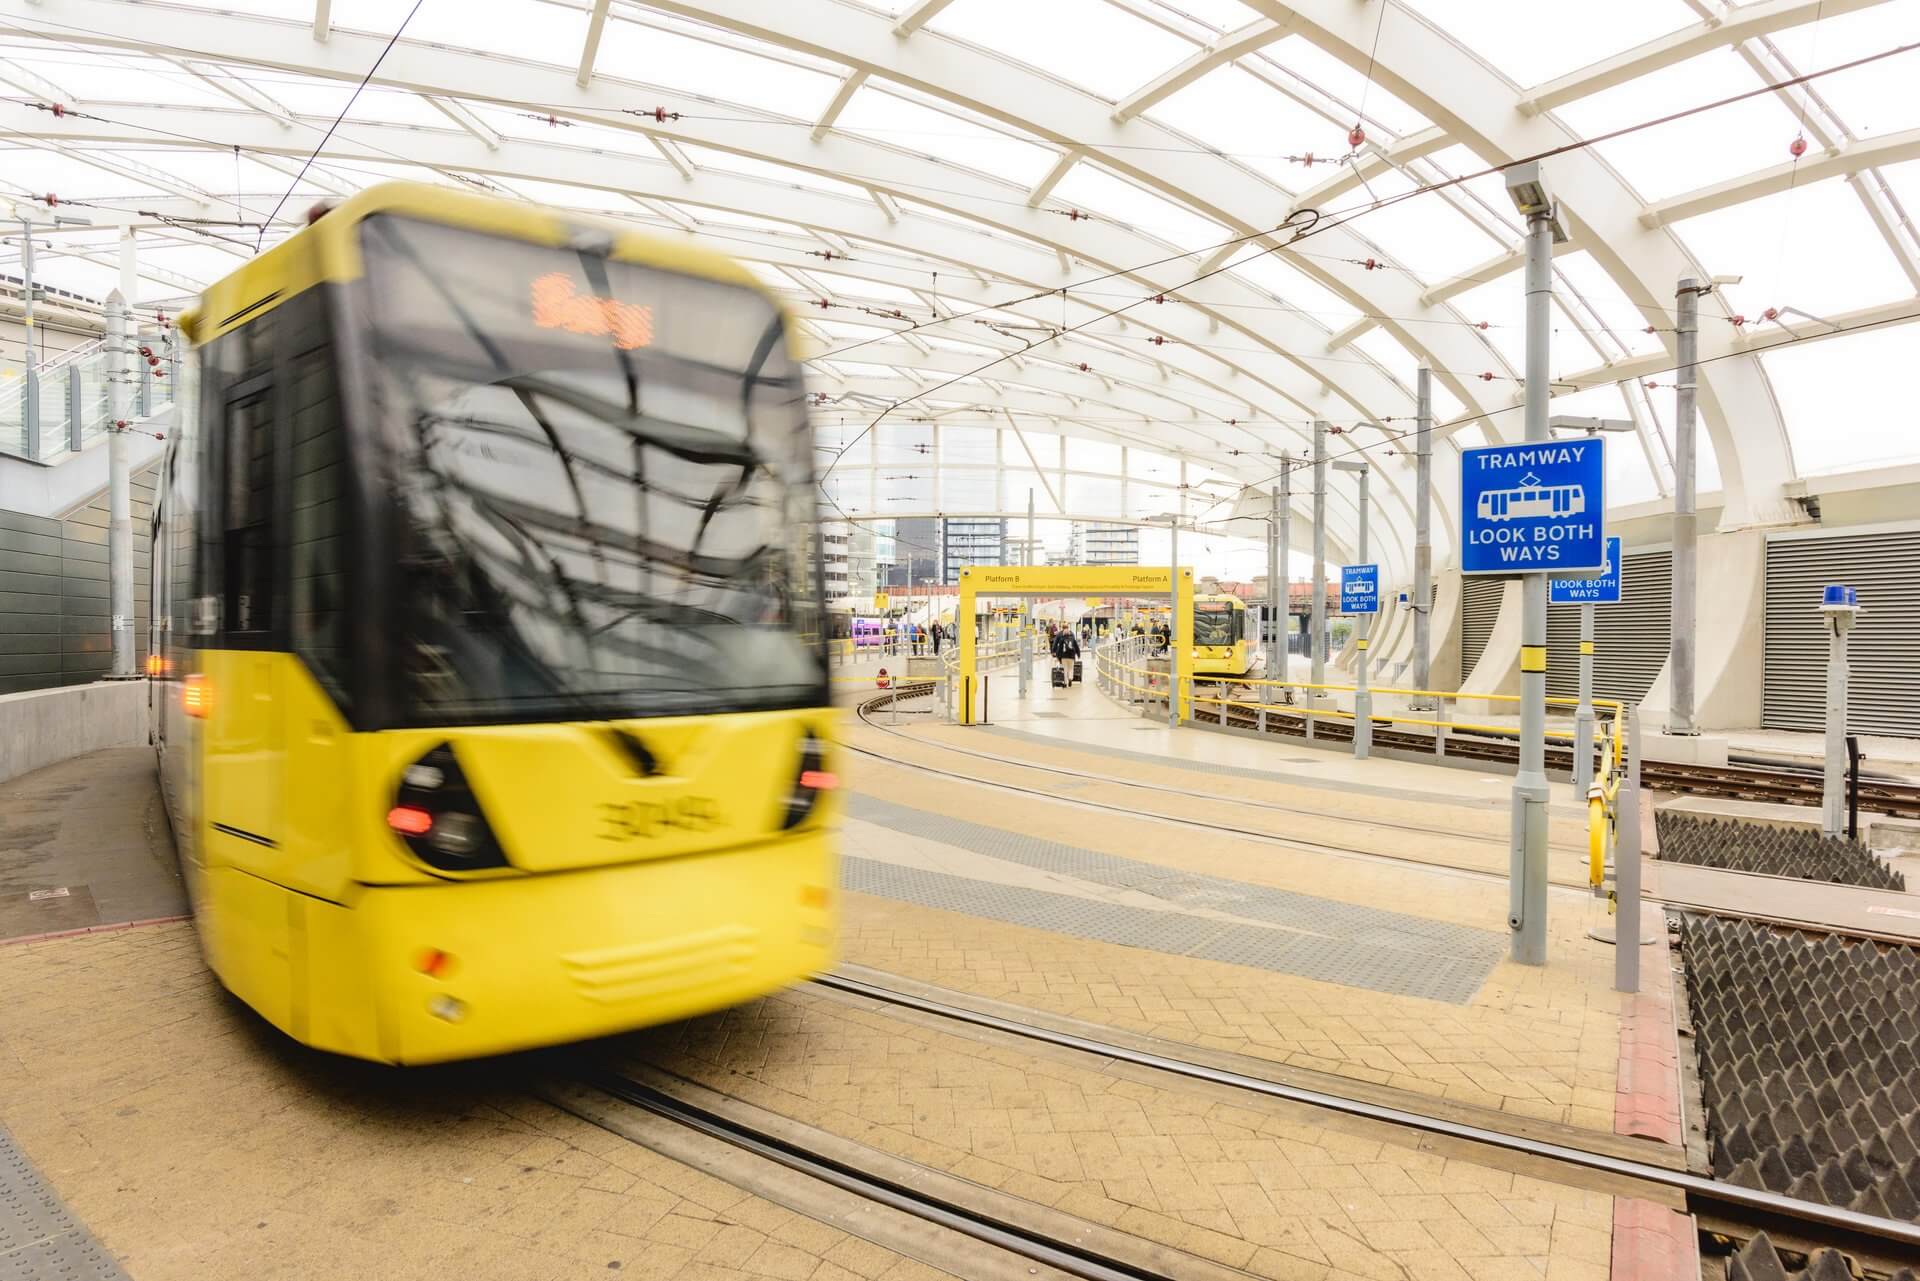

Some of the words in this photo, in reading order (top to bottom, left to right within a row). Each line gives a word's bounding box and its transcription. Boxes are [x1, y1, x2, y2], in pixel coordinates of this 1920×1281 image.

[1477, 447, 1586, 470] TRAMWAY
[1470, 527, 1526, 545] LOOK
[1534, 524, 1594, 542] BOTH
[1500, 545, 1560, 562] WAYS
[985, 575, 1014, 583] Platform
[1015, 575, 1020, 583] B
[1132, 575, 1161, 583] Platform
[1162, 575, 1168, 583] A
[1554, 580, 1583, 589] LOOK
[1586, 579, 1616, 588] BOTH
[1569, 589, 1600, 598] WAYS
